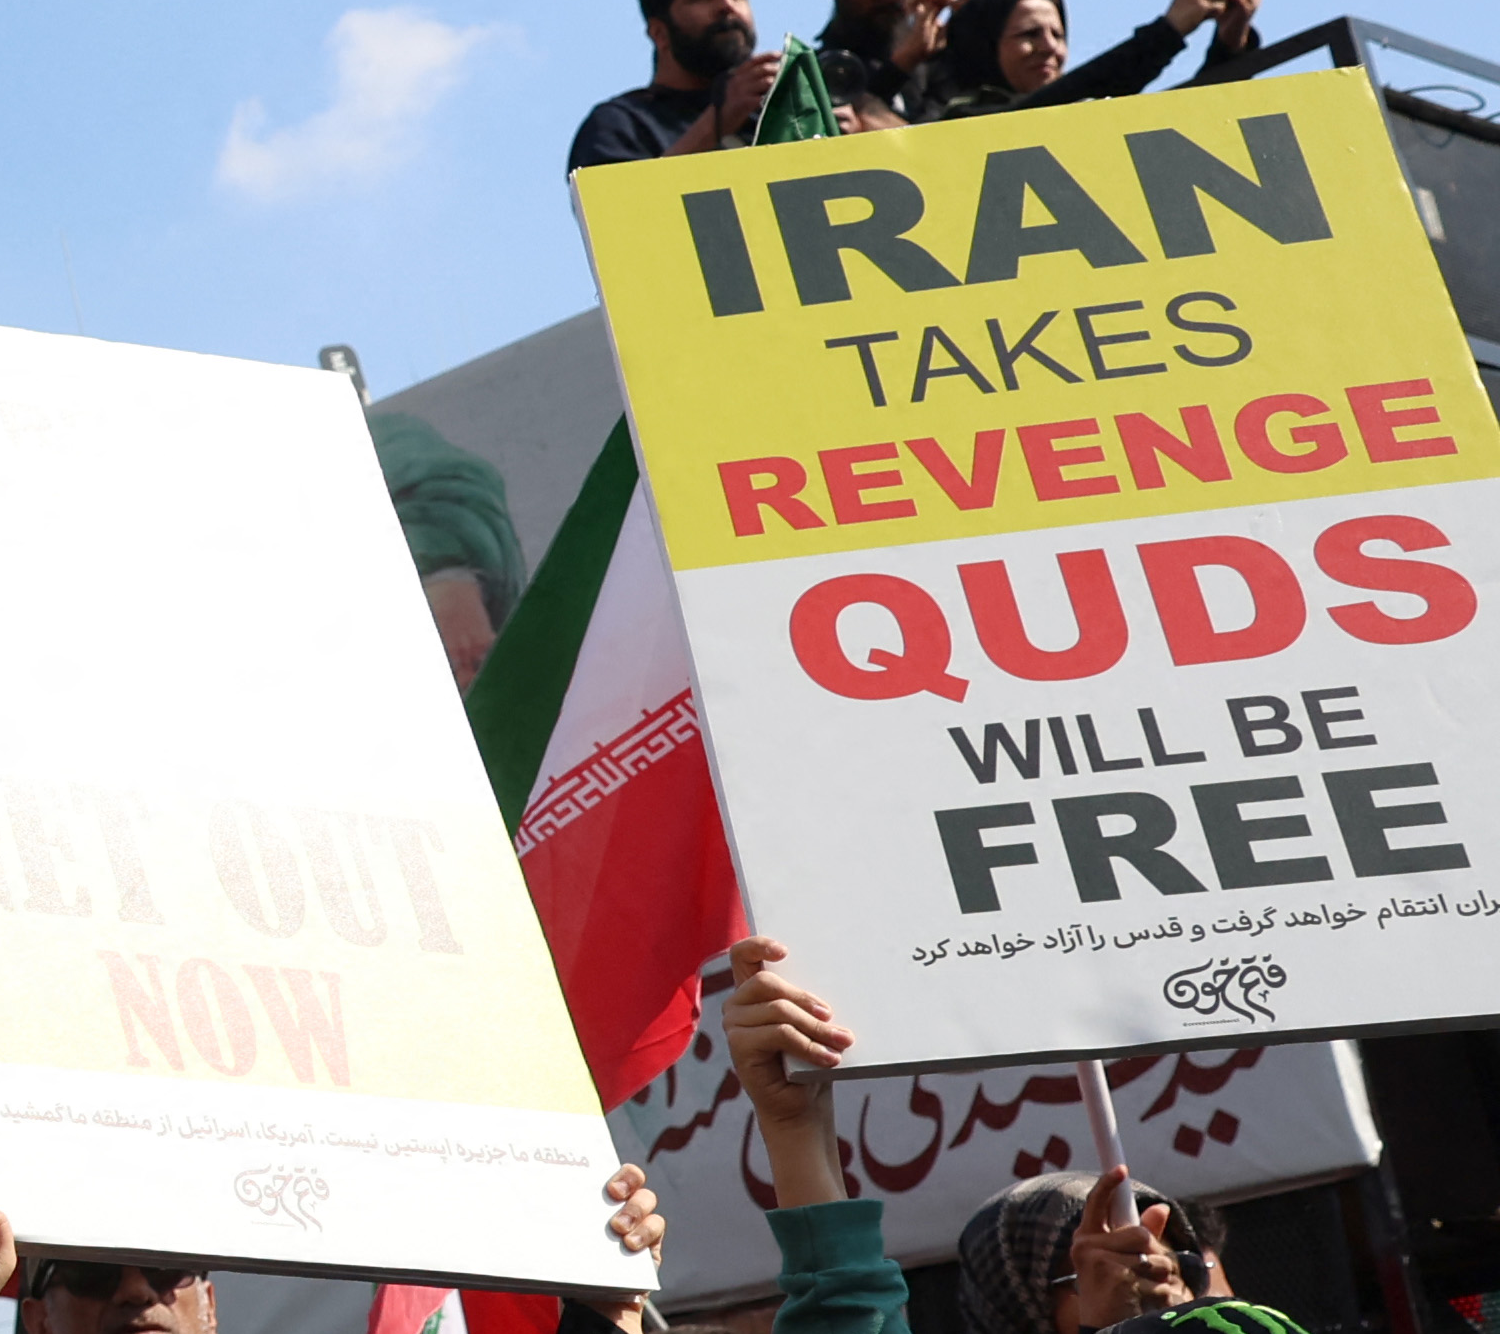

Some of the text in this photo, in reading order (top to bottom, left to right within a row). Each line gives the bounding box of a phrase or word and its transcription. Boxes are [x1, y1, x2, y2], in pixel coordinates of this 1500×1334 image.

[680, 111, 1333, 317] IRAN
[824, 292, 1252, 407] TAKES
[718, 378, 1457, 537] REVENGE
[790, 515, 1478, 702] QUDS
[948, 687, 1377, 784] WILL BE
[934, 763, 1470, 916] FREE
[208, 795, 464, 956] OUT
[1213, 907, 1276, 936] گرفت
[1285, 904, 1366, 929] خواهد
[1378, 894, 1447, 929] انتقام
[958, 934, 1034, 959] خواهد
[1044, 925, 1082, 953] آزاد
[1091, 927, 1107, 951] را
[1114, 917, 1182, 948] قدس
[1191, 925, 1205, 942] و
[913, 939, 949, 966] کرد
[97, 948, 352, 1088] NOW
[92, 1110, 152, 1130] منطقه
[508, 1143, 529, 1162] ما
[533, 1147, 590, 1168] منطقه
